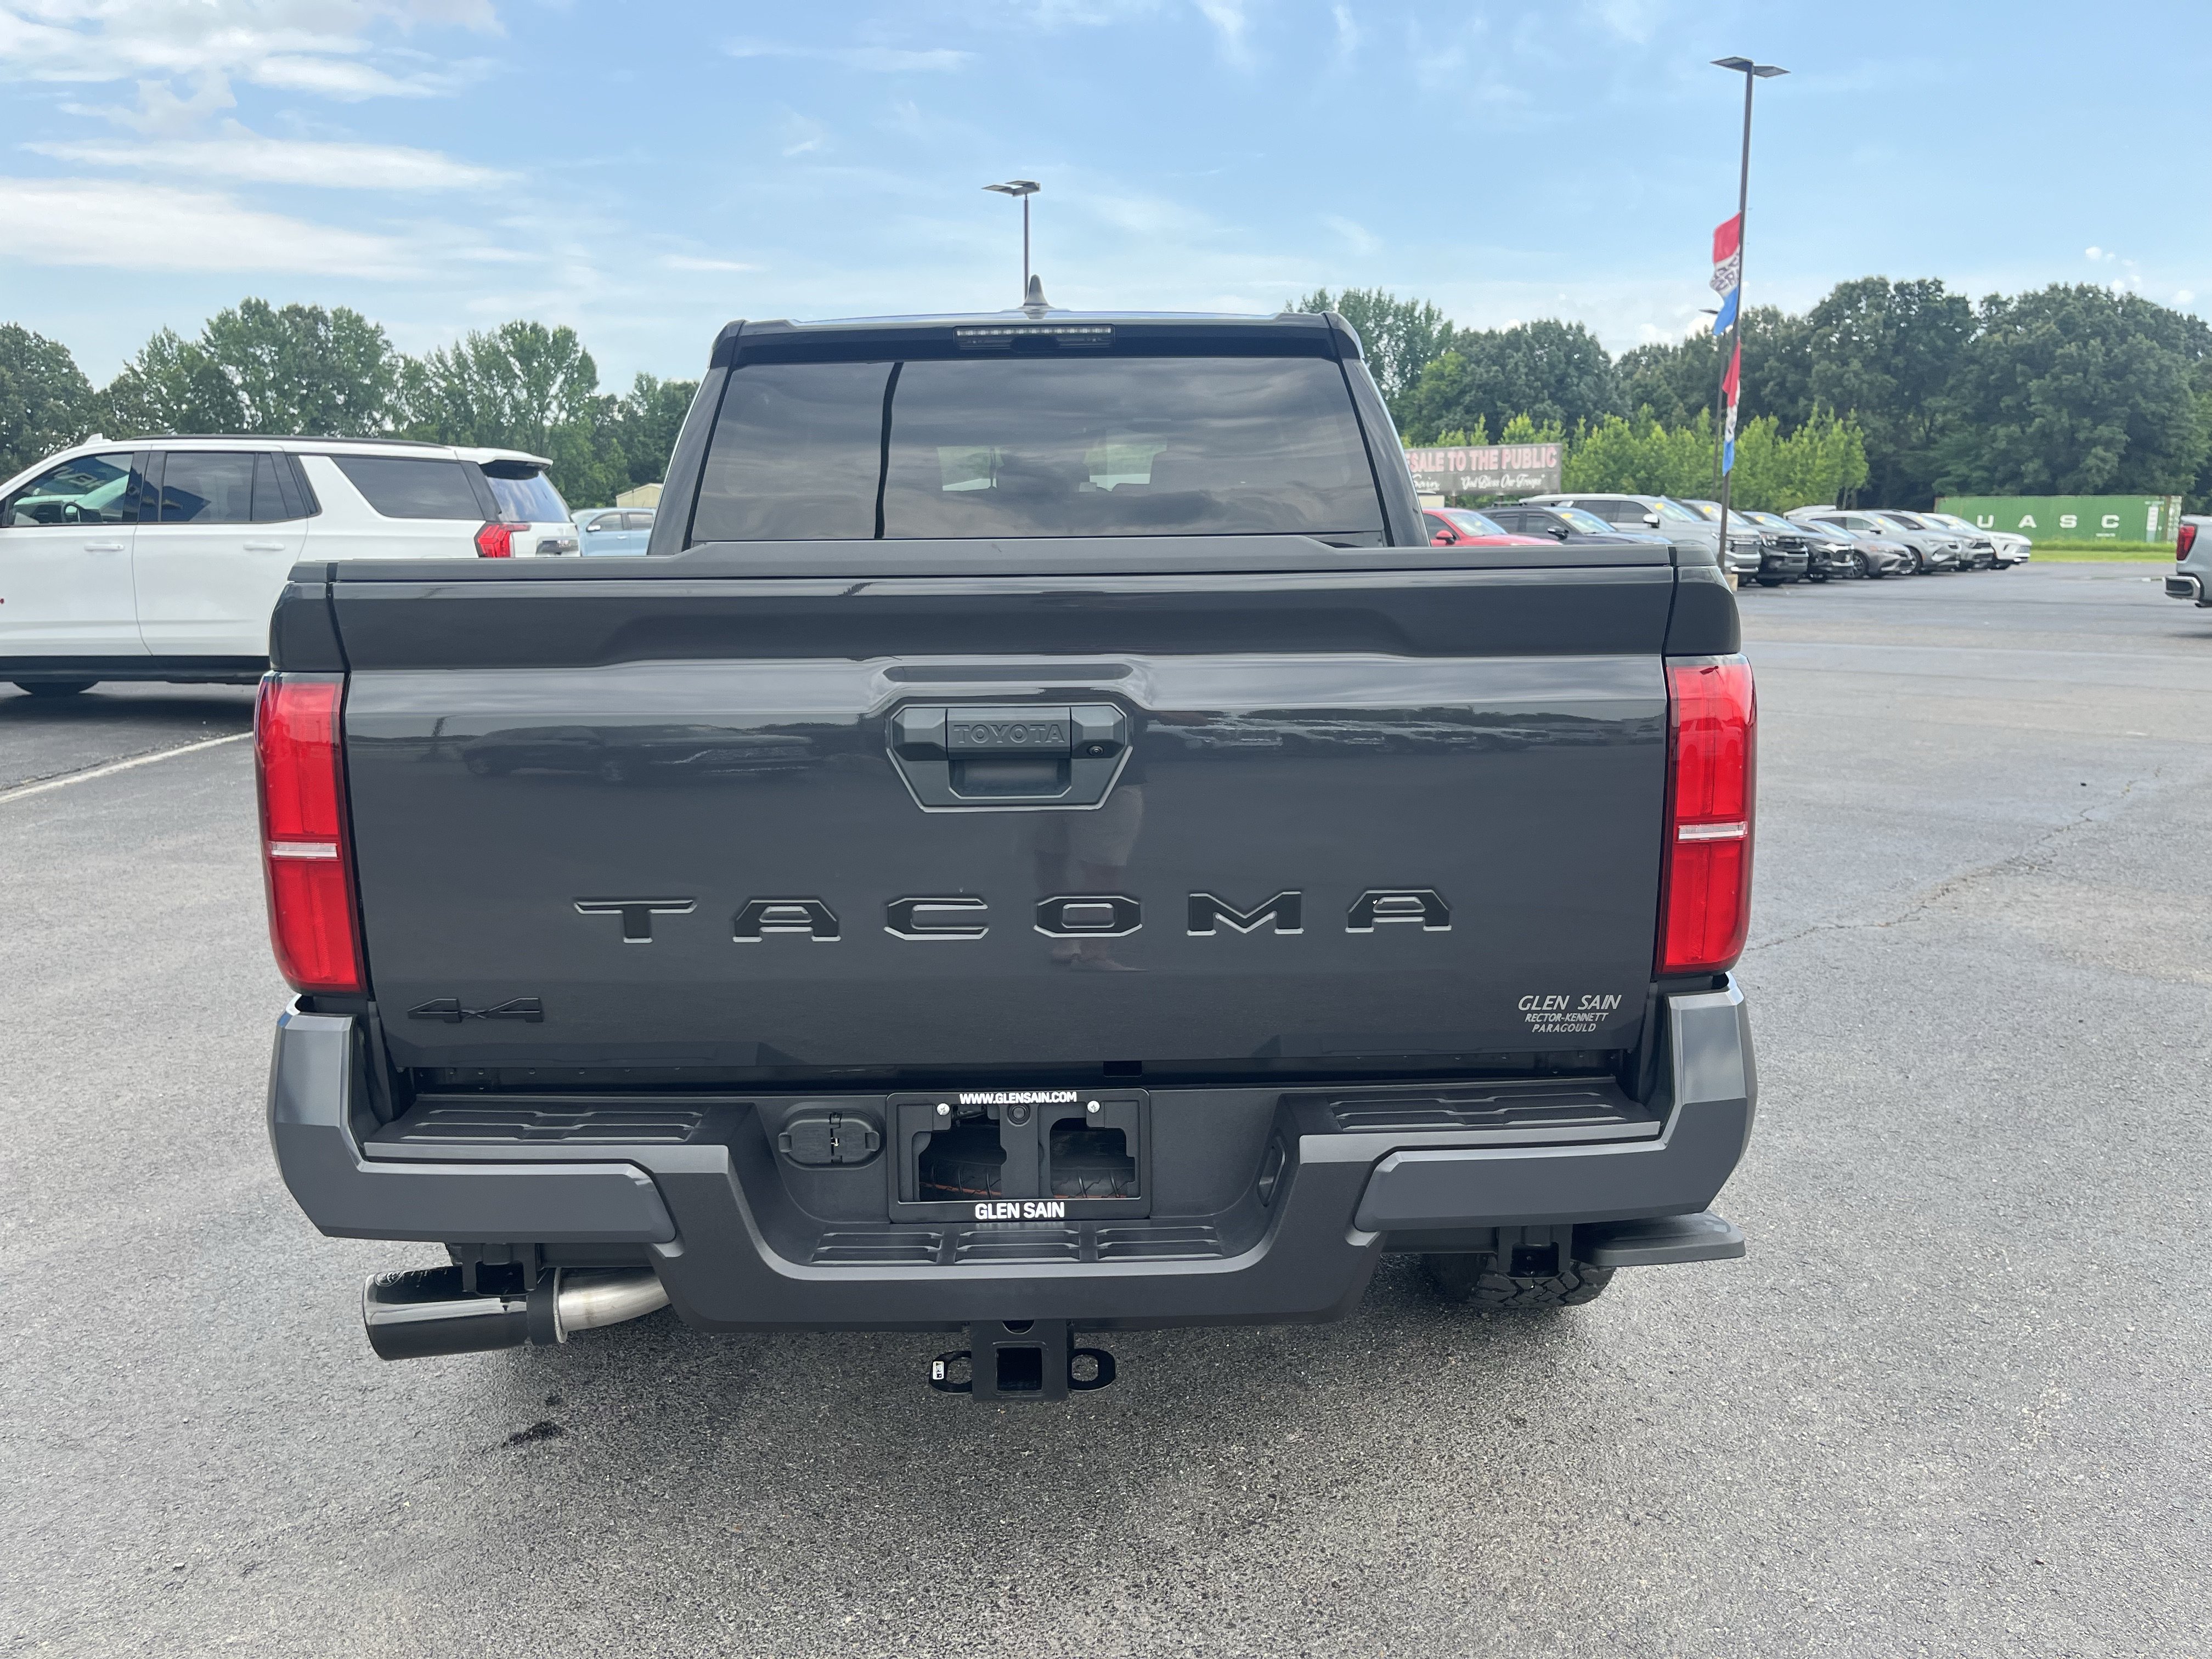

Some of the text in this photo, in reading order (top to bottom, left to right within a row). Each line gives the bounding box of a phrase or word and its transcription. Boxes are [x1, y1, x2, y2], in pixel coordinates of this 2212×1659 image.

[1447, 452, 1466, 472] TO
[1469, 450, 1498, 470] THE
[1502, 447, 1557, 470] PUBLIC
[953, 724, 1065, 743] TOYOTA
[574, 889, 1452, 944] TACOMA
[1518, 995, 1622, 1011] GLEN SAIN
[1525, 1013, 1609, 1023] RECTOR-KENNETT
[1532, 1023, 1597, 1032] PARAGOULD
[960, 1091, 1077, 1104] WWW.GLENSAIN.COM
[975, 1201, 1065, 1220] GLEN SAIN
